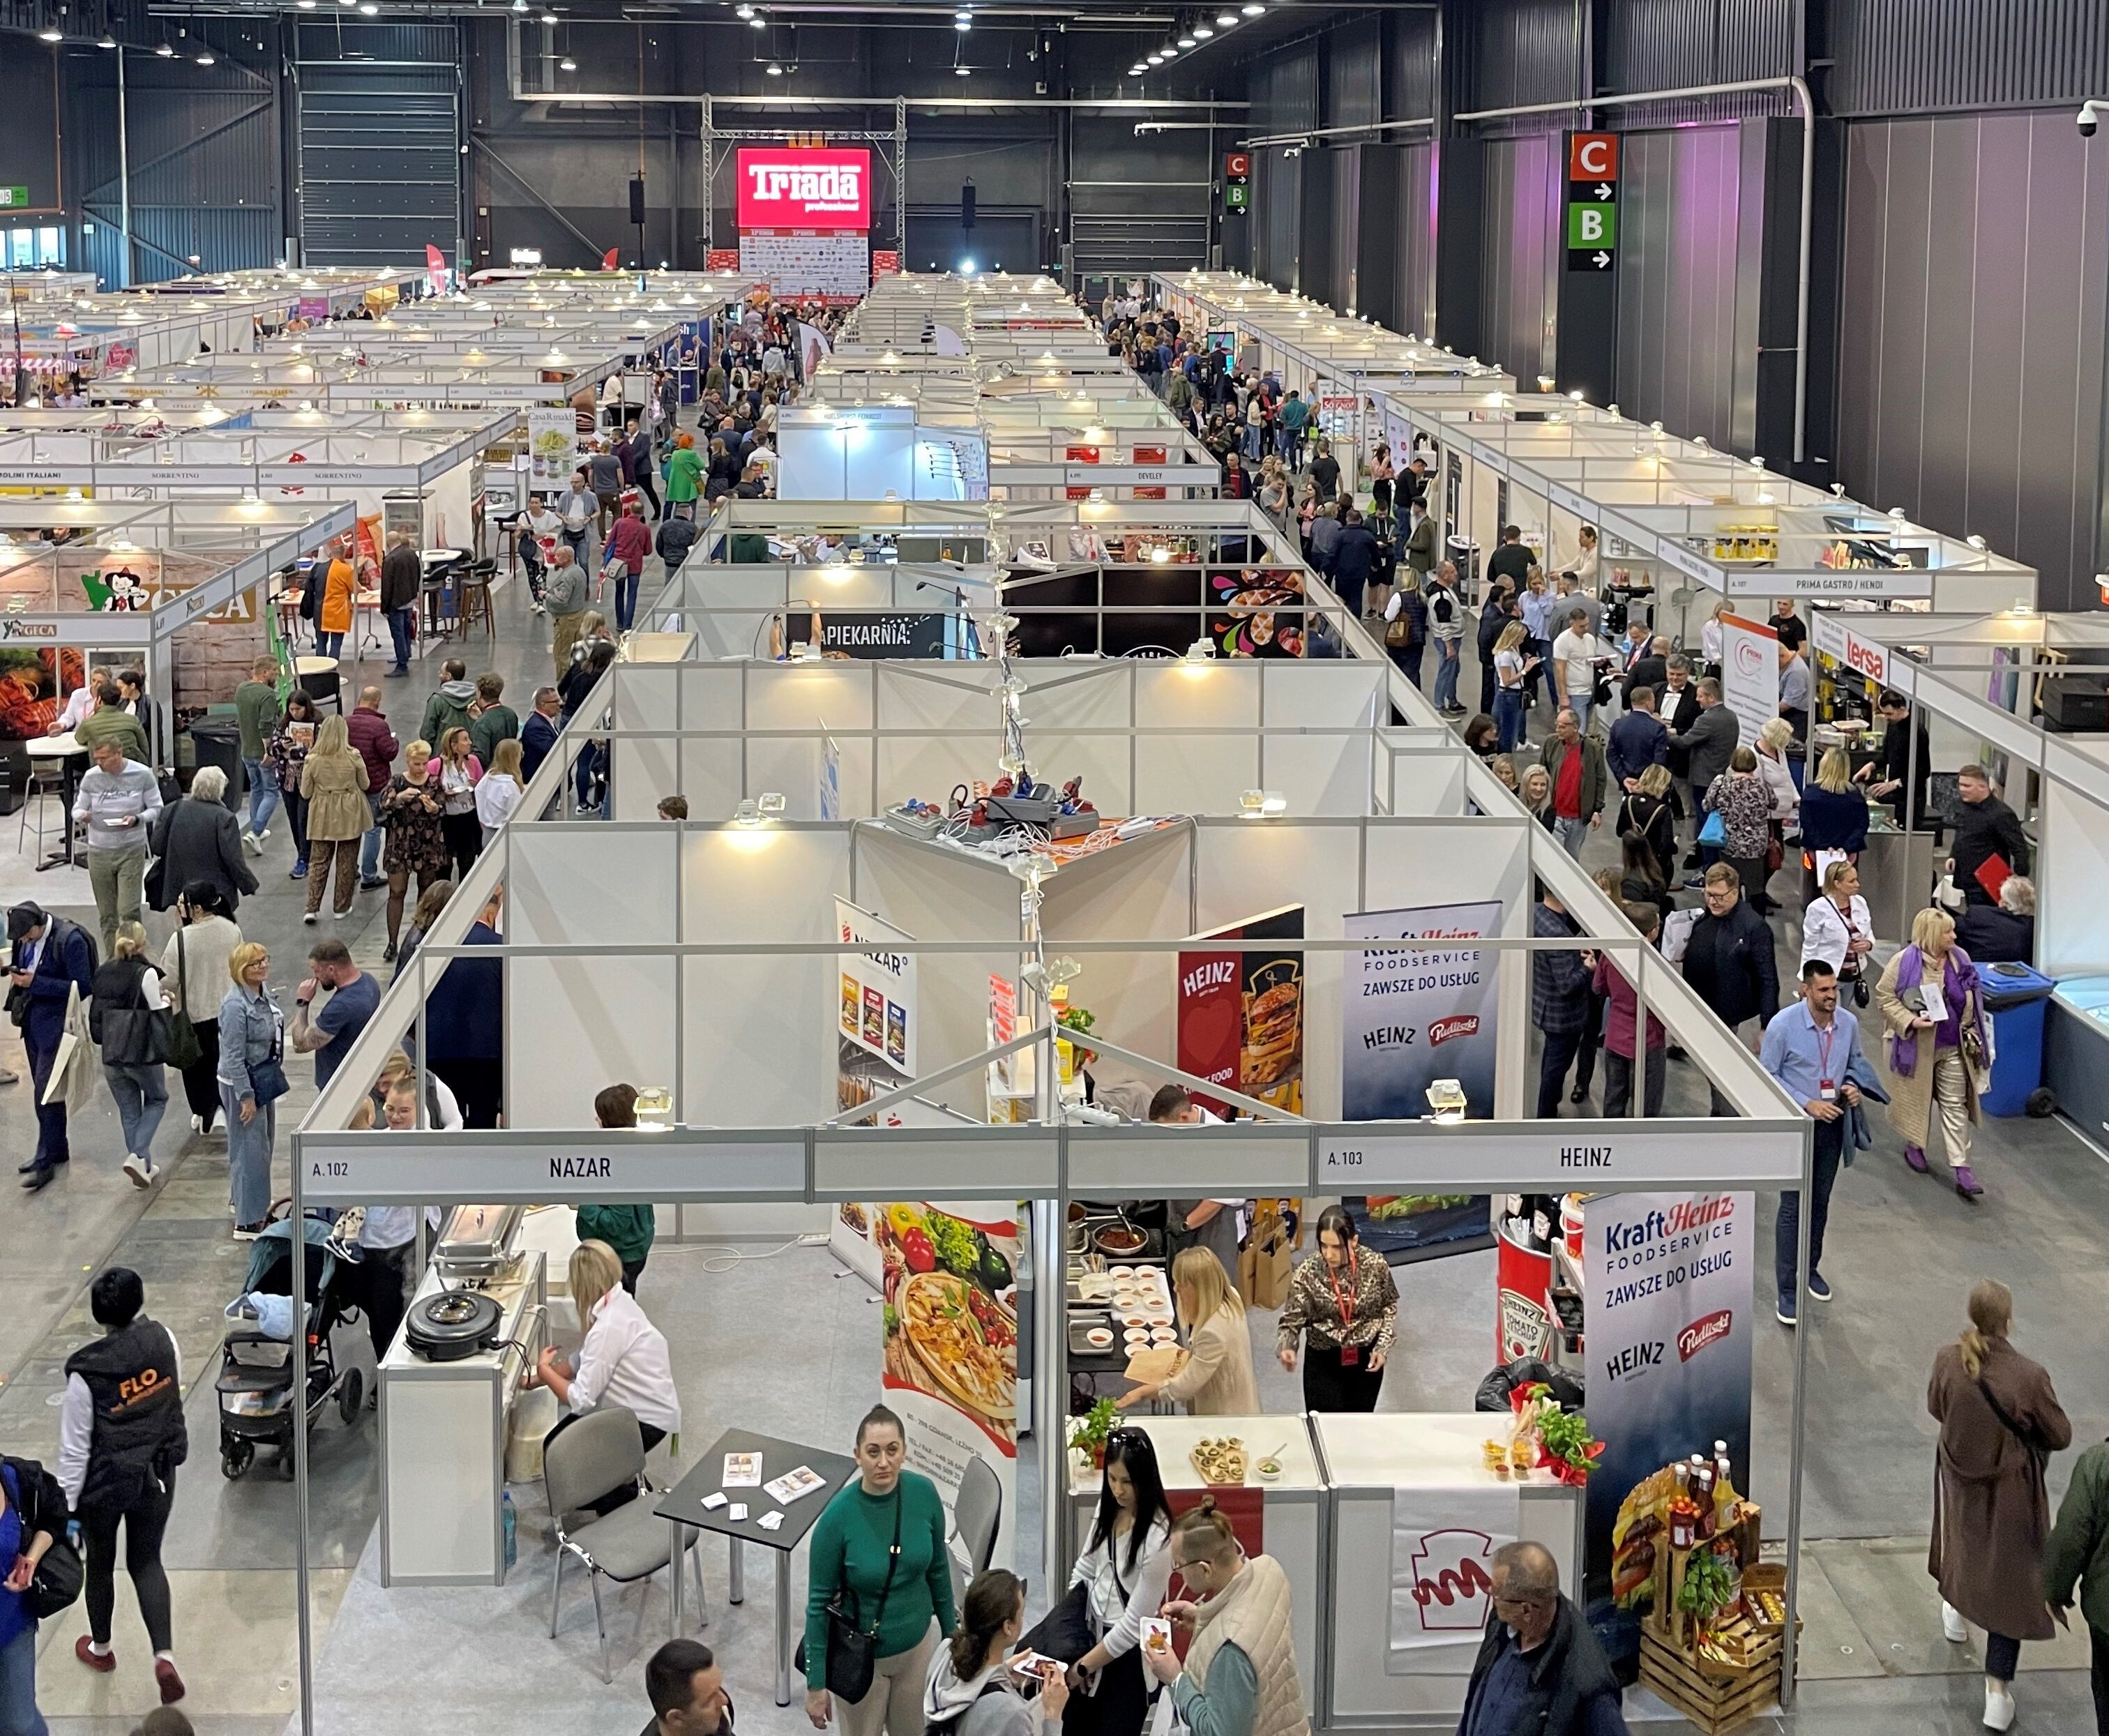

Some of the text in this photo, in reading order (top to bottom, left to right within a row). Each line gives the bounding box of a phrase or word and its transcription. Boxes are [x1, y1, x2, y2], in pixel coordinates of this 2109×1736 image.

[1232, 157, 1244, 173] C
[1581, 141, 1607, 174] C
[748, 165, 861, 200] Triada
[1232, 187, 1243, 203] B
[805, 202, 859, 212] professional
[1582, 210, 1604, 241] B
[1797, 580, 1821, 589] PRIMA
[1823, 580, 1853, 589] GASTRO
[1860, 580, 1884, 589] HENDI
[1847, 632, 1883, 679] tersa
[1363, 951, 1481, 972] FOODSERVICE
[1183, 961, 1235, 997] HEINZ
[1363, 971, 1480, 997] ZAWSZE DO USŁUG
[1363, 1026, 1416, 1050] HEINZ
[1211, 1067, 1233, 1083] FOOD
[312, 1158, 612, 1179] A.102 NAZAR
[1328, 1147, 1612, 1168] A.103 HEINZ
[1605, 1195, 1735, 1255] Kraft Heinz
[1606, 1222, 1733, 1274] FOODSERVICE
[1605, 1250, 1732, 1308] ZAWSZE DO USŁUG
[1509, 1300, 1536, 1320] HEINZ
[1506, 1311, 1539, 1336] TOMATO
[1605, 1341, 1665, 1382] HEINZ
[120, 1368, 158, 1398] FLO
